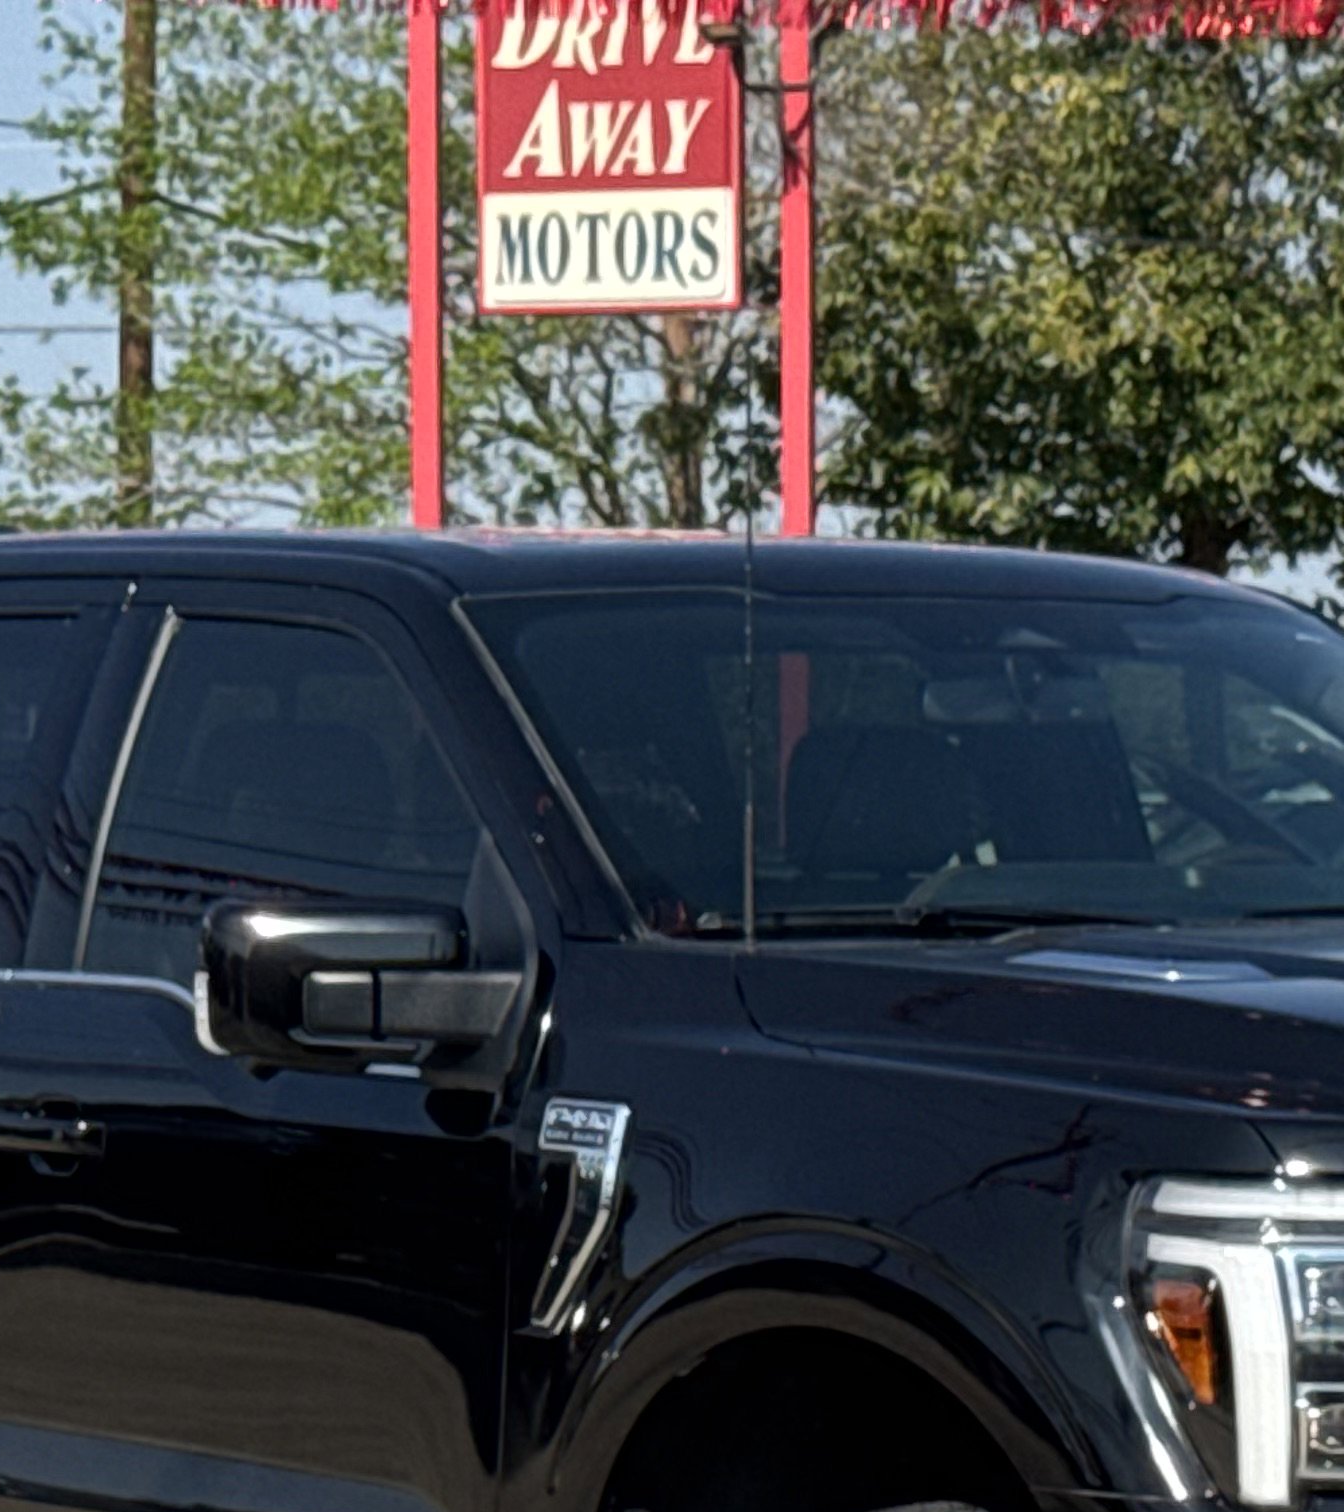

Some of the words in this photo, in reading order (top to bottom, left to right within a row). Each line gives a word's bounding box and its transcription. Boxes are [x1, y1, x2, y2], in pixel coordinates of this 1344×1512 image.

[491, 0, 715, 75] DRIVE
[503, 79, 711, 178] AWAY
[495, 208, 720, 289] MOTORS
